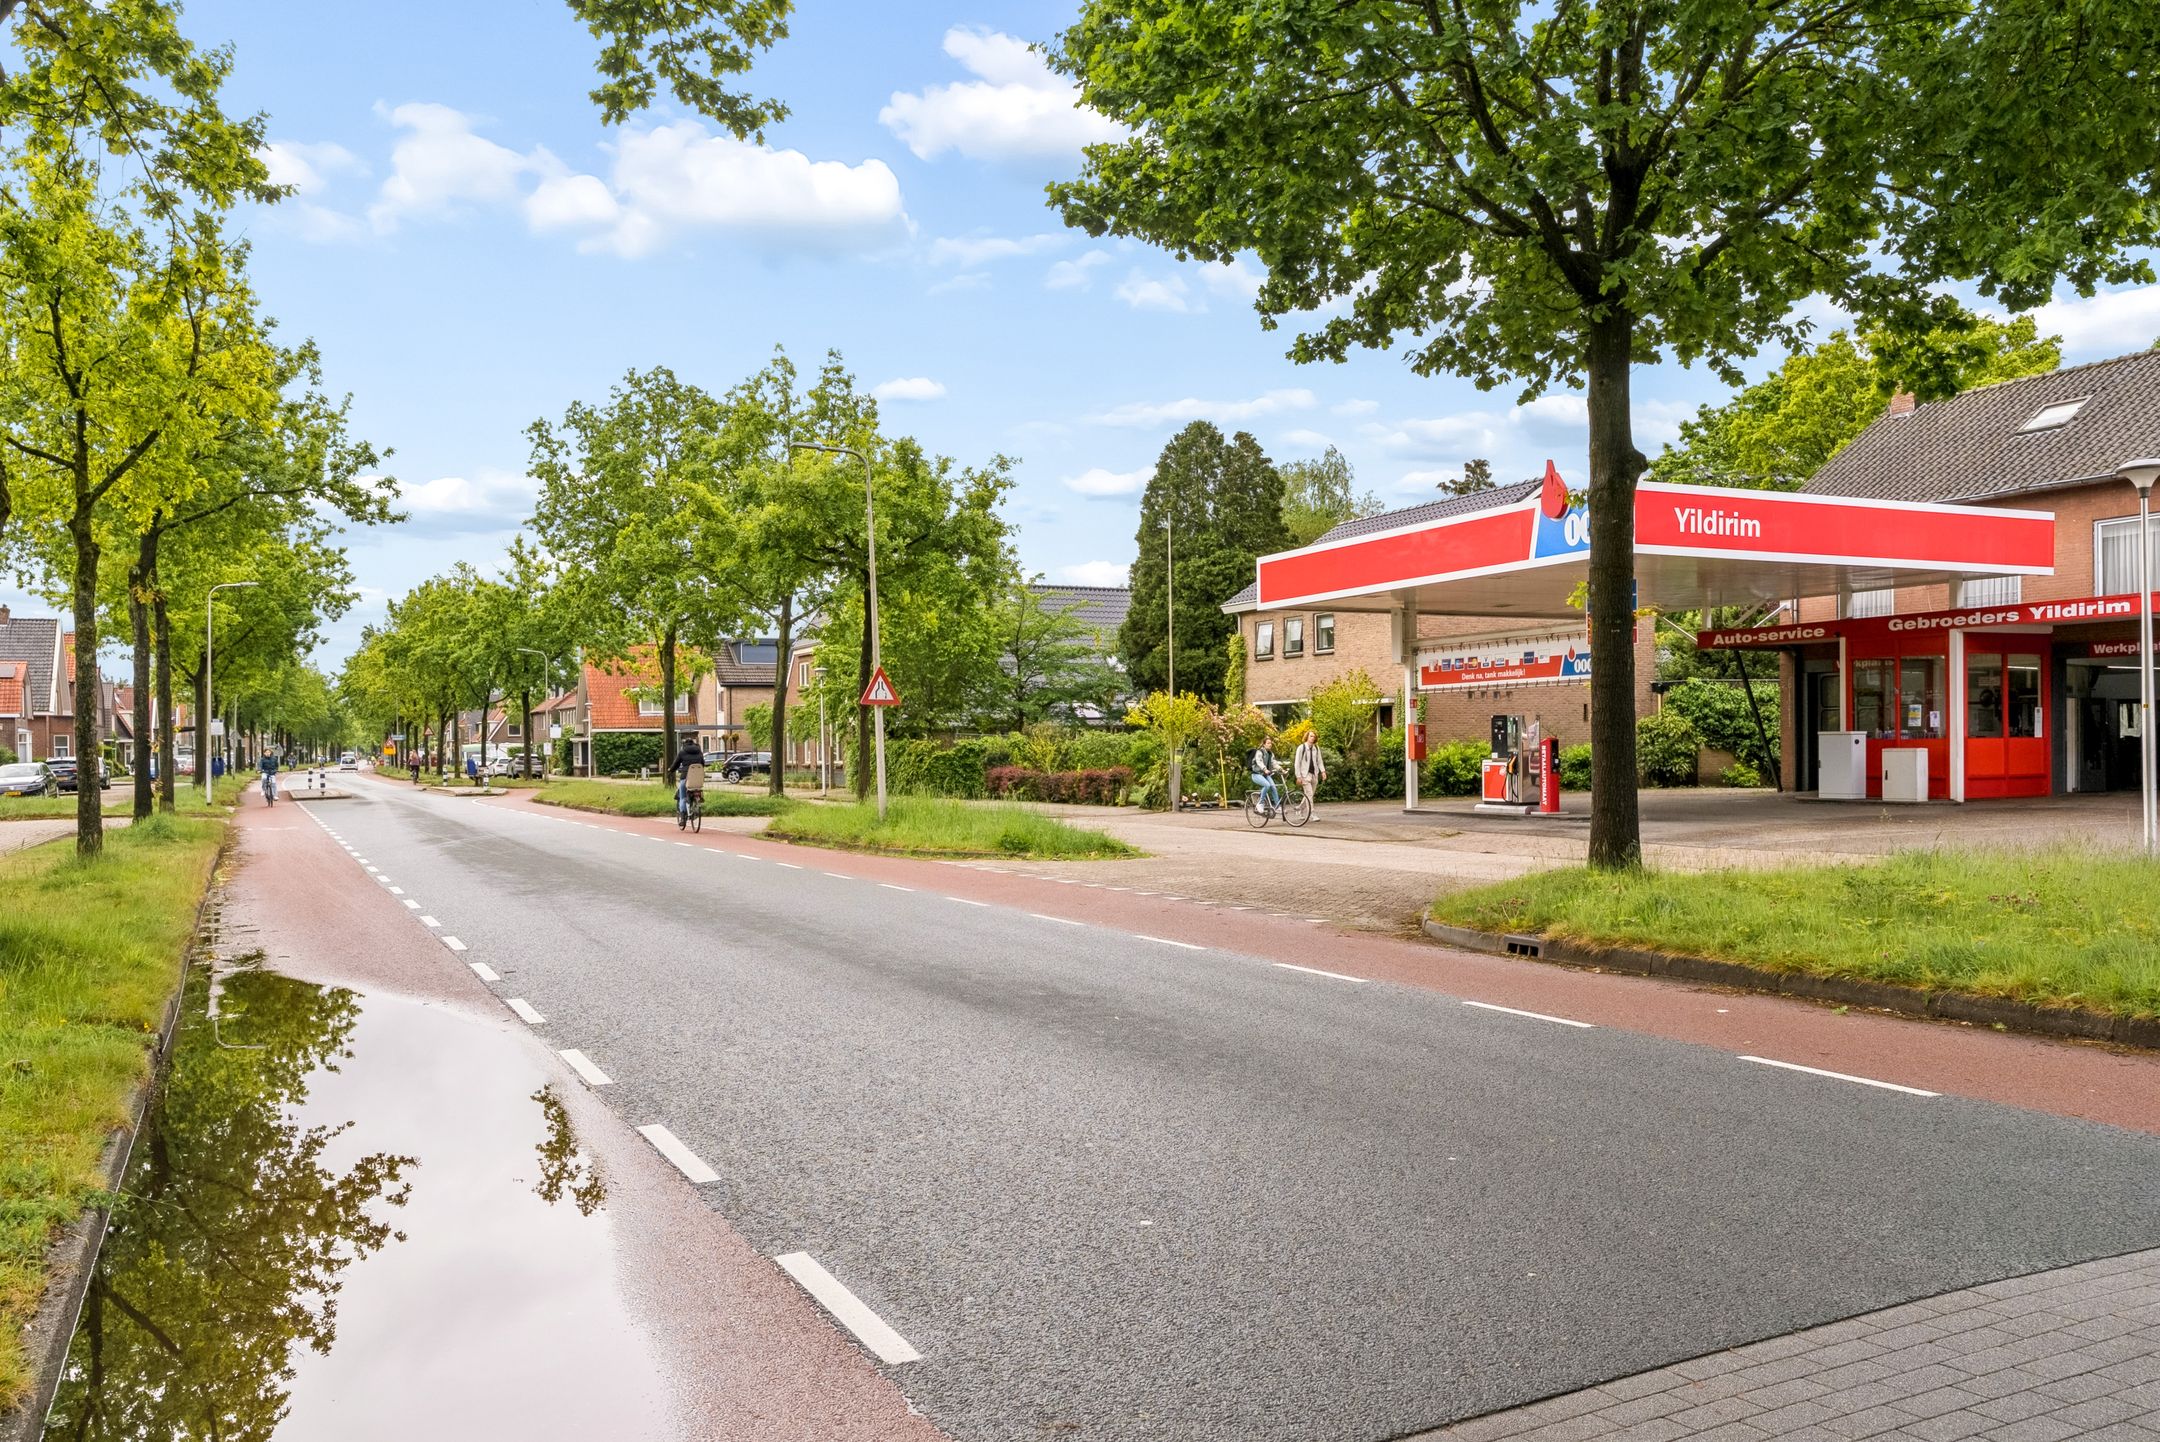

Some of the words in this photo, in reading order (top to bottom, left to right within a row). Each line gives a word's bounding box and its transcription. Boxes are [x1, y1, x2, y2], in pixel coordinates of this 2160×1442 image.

[1674, 507, 1761, 538] Yildirim
[1888, 610, 2019, 632] Gebroeders
[2029, 600, 2130, 620] Yildirim
[1713, 627, 1825, 646] Auto-service
